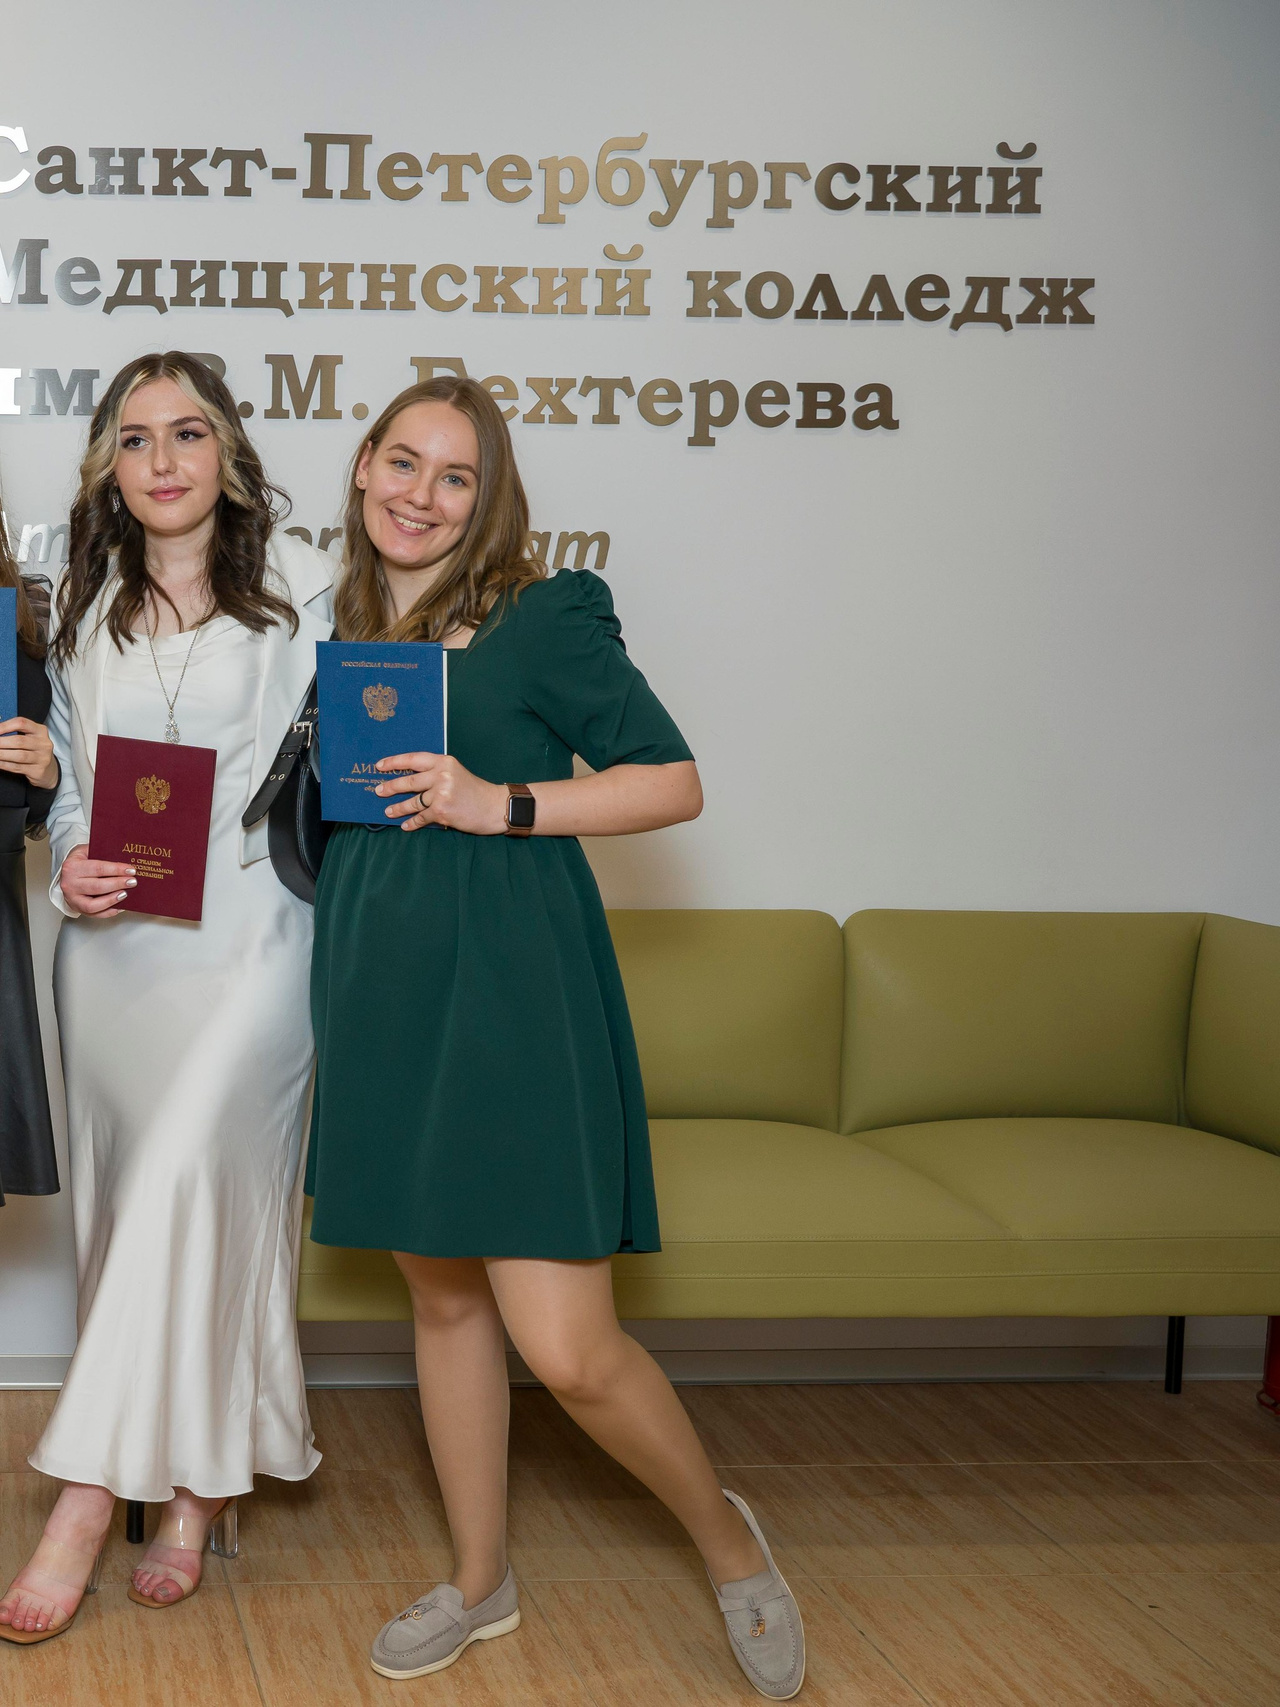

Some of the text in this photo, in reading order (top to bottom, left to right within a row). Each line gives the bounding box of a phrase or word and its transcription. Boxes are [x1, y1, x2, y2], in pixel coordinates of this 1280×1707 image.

[686, 271, 1096, 332] колледж
[185, 353, 369, 420] .М.
[122, 843, 172, 858] ДИПЛОМ
